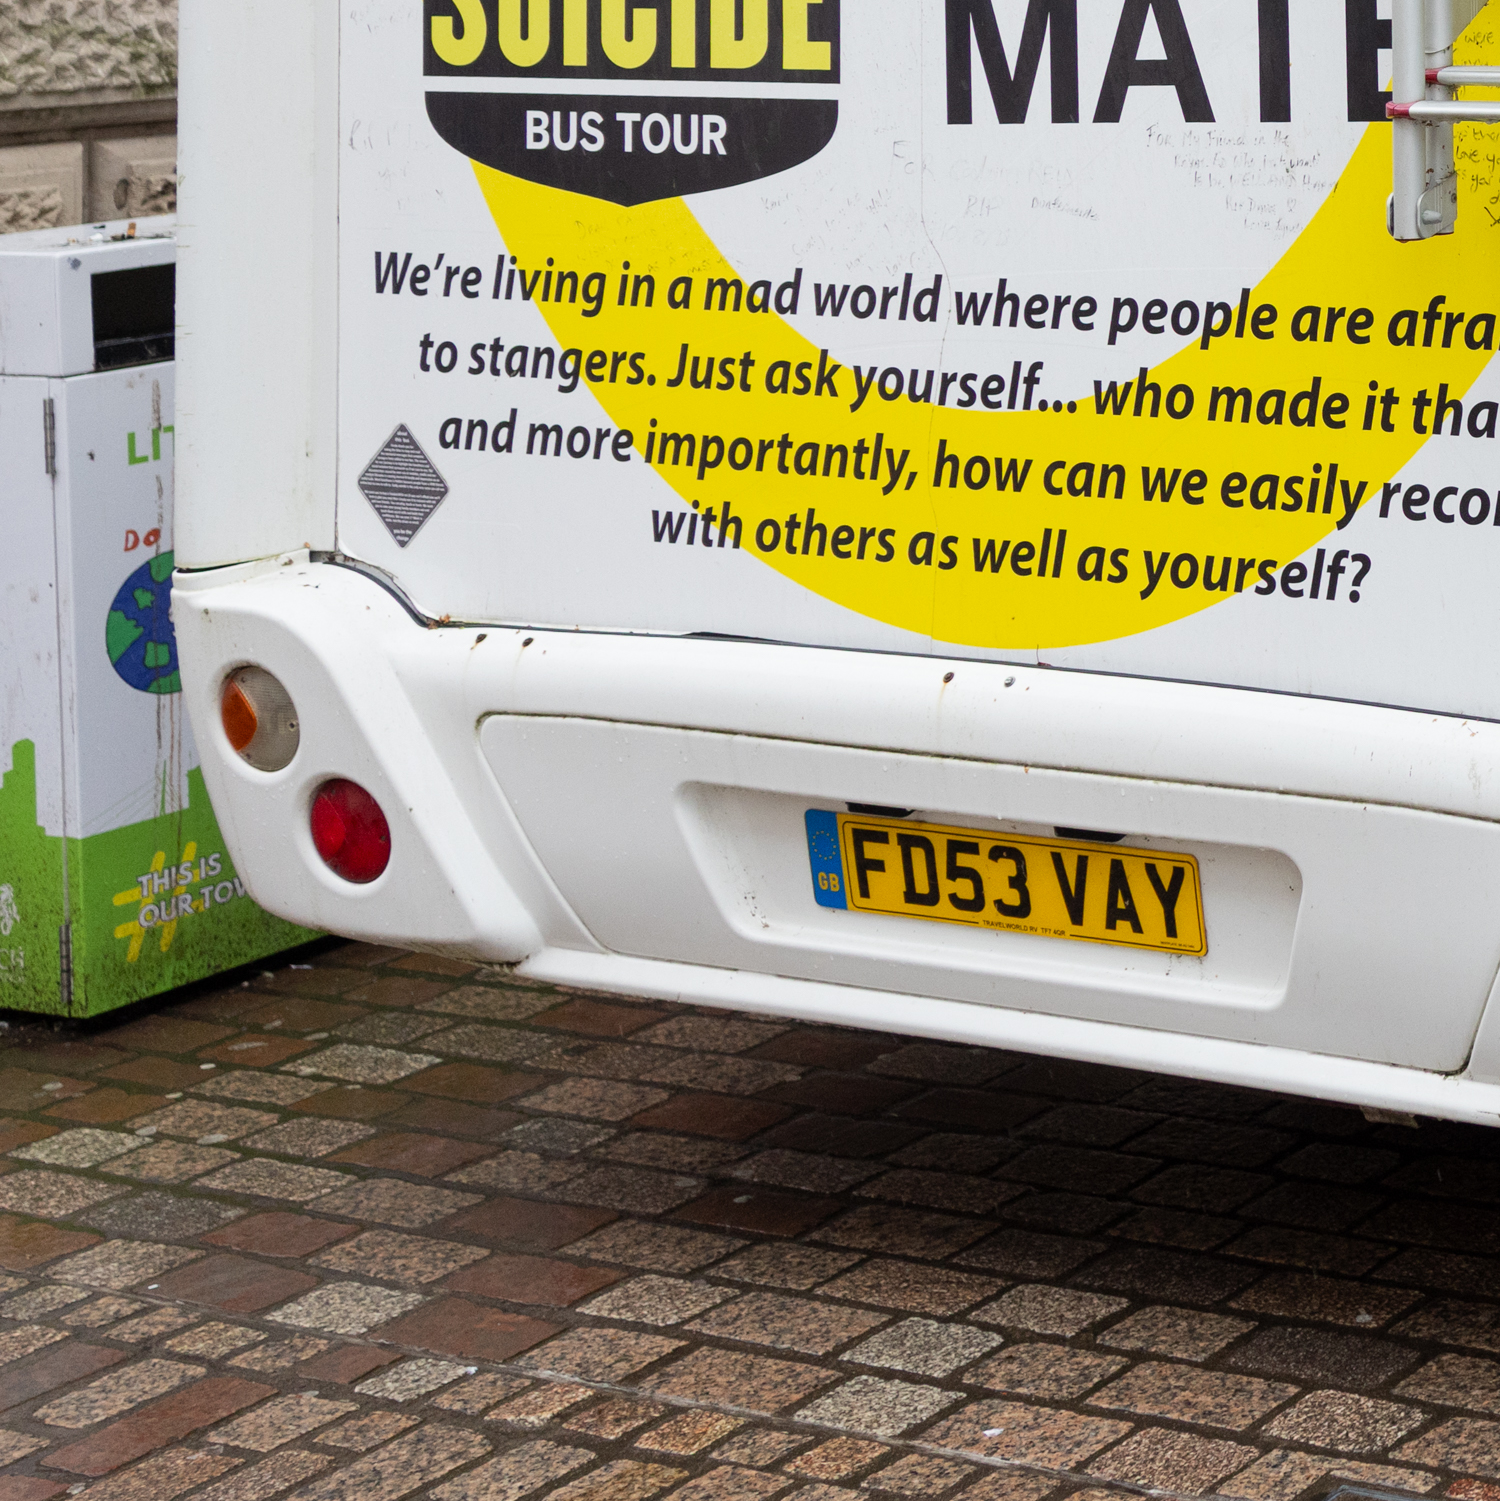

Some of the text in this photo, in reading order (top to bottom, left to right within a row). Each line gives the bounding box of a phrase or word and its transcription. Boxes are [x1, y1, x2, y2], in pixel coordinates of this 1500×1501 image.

[525, 110, 727, 155] BUS TOUR
[492, 255, 605, 315] living
[617, 261, 656, 309] in
[666, 276, 692, 310] a
[704, 267, 802, 317] mad
[813, 274, 943, 323] world
[954, 278, 1097, 332] where
[1107, 288, 1279, 350] people
[1291, 305, 1374, 346] are
[418, 332, 459, 374] to
[467, 336, 656, 394] stangers.
[666, 343, 754, 392] Just
[764, 349, 840, 399] ask
[1093, 368, 1194, 414] who
[1208, 377, 1350, 431] made
[1361, 382, 1398, 433] it
[438, 408, 516, 454] and
[526, 418, 634, 462] more
[643, 418, 919, 497] importantly,
[933, 439, 1030, 494] how
[1043, 457, 1126, 501] can
[1140, 466, 1208, 506] we
[1220, 462, 1368, 531] easily
[650, 500, 1373, 605] with others as well as yourself?
[136, 852, 222, 899] THIS IS
[138, 892, 195, 929] OUR
[817, 870, 841, 893] GB
[851, 828, 1185, 939] FD53 VAY
[982, 919, 1029, 933] TRAVELWORLD
[1029, 925, 1038, 933] RV
